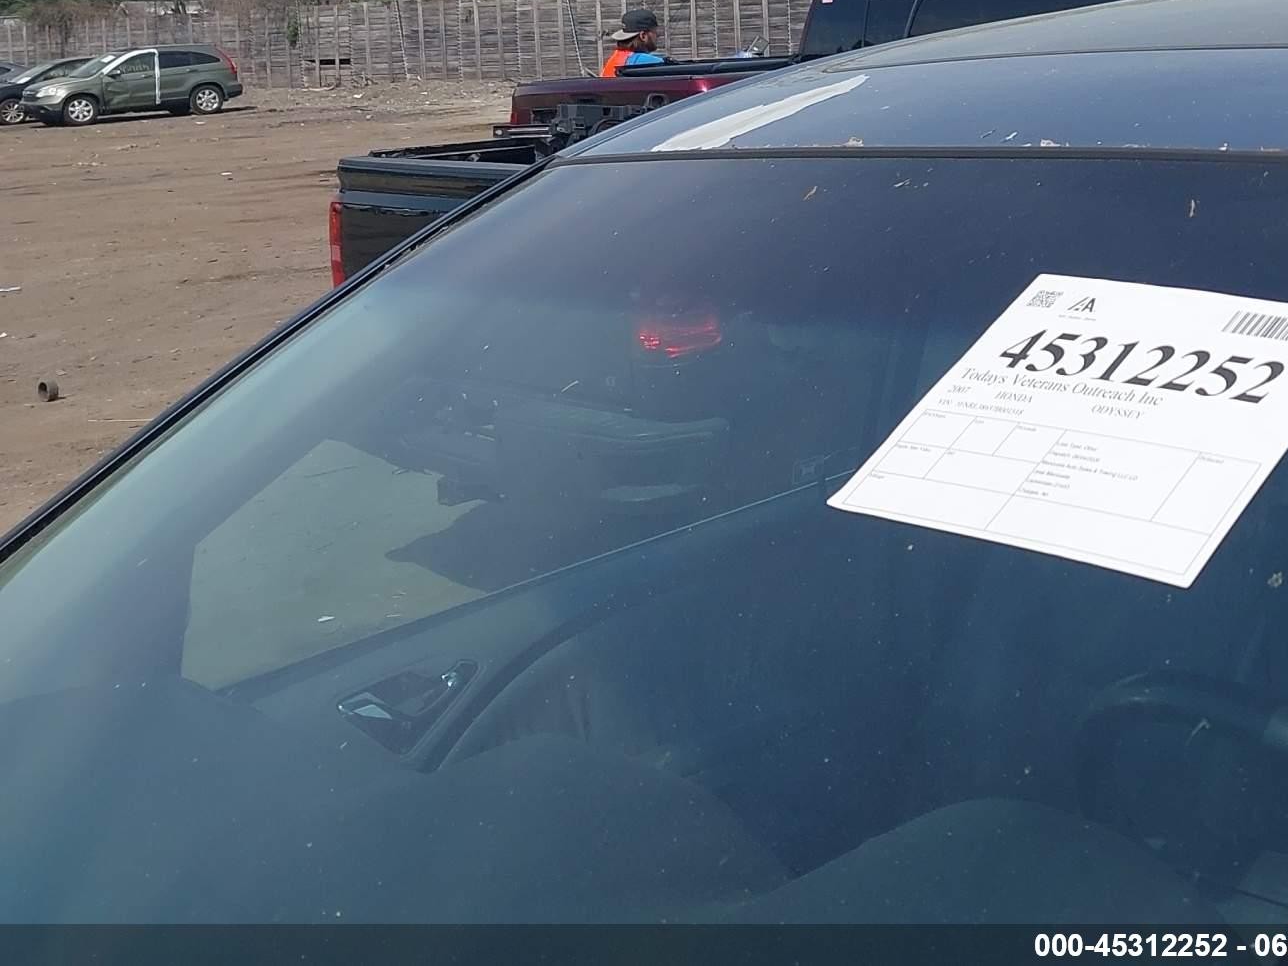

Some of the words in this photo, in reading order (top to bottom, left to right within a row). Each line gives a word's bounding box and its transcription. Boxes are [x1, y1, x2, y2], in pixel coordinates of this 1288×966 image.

[960, 366, 1009, 386] Todays
[1011, 372, 1070, 395] Veterans
[1071, 381, 1136, 404] Outreach
[1138, 393, 1165, 407] Inc
[999, 329, 1286, 404] 45312252
[993, 390, 1034, 404] HONDA
[1090, 404, 1145, 420] ODYSSEY
